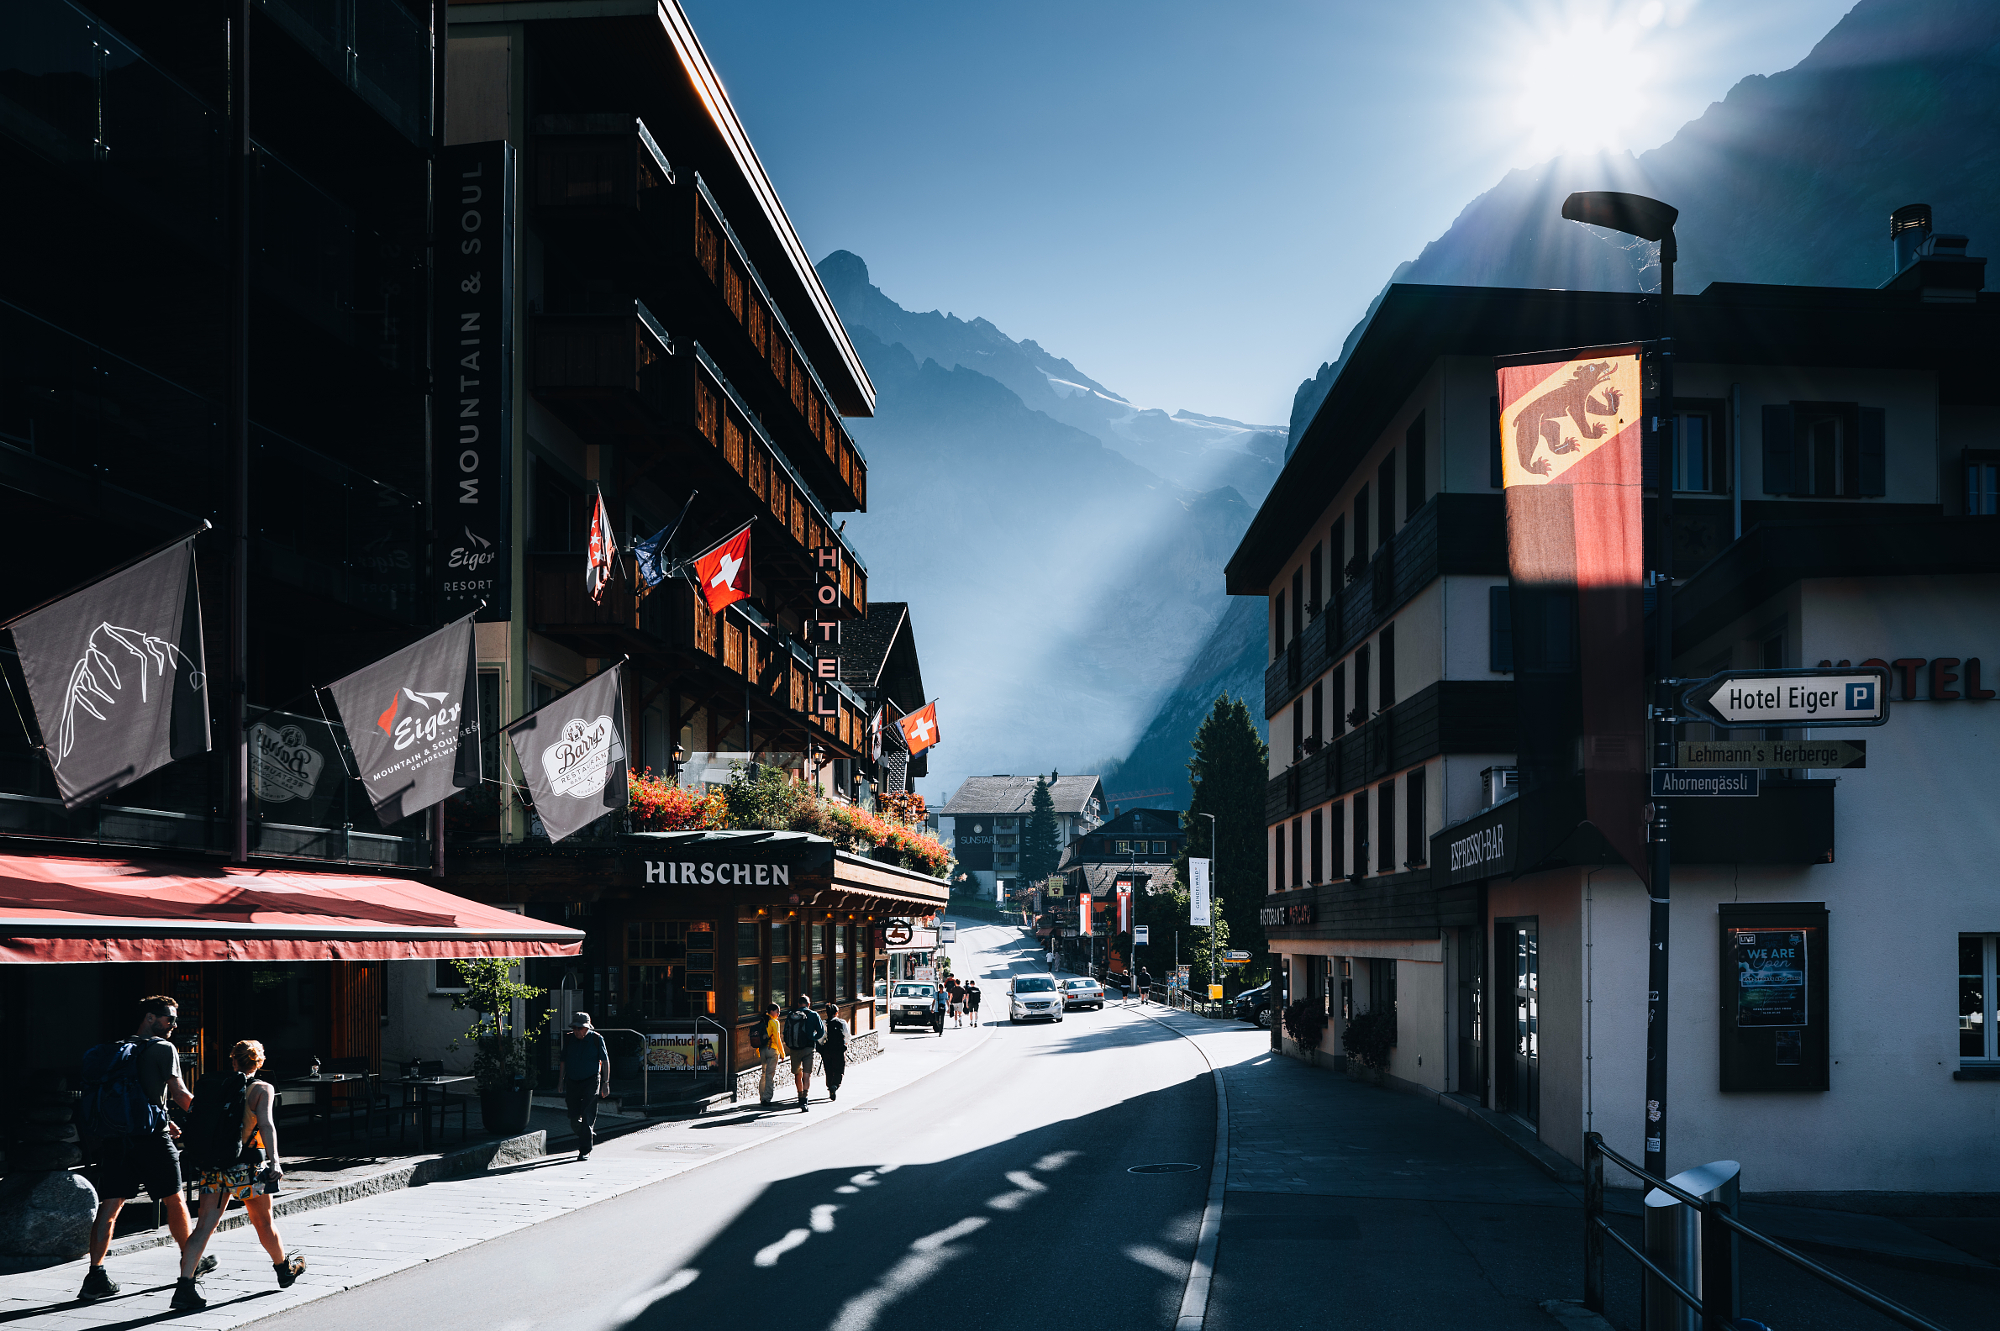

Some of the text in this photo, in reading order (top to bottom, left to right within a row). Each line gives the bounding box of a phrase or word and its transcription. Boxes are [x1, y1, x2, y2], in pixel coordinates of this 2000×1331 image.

[459, 161, 483, 504] MOUNTAIN & SOUL
[448, 547, 495, 571] Eiger
[444, 579, 493, 592] RESORT
[817, 548, 837, 715] HOTEL
[1730, 686, 1781, 709] Hotel
[1789, 686, 1838, 713] Eiger
[394, 702, 461, 750] Eiger
[373, 753, 422, 781] MOUNTAIN
[423, 748, 431, 756] &
[432, 735, 459, 751] SOUL
[411, 742, 462, 771] GRINDELWALD
[1688, 745, 1838, 764] Lehmann's Herberge
[1662, 773, 1748, 795] Ahornengässli
[960, 835, 995, 845] SUNSTAR
[1451, 823, 1504, 871] ESPRESSO-BAR
[644, 861, 789, 885] HIRSCHEN
[1747, 948, 1796, 959] WE ARE
[1753, 954, 1791, 972] Open
